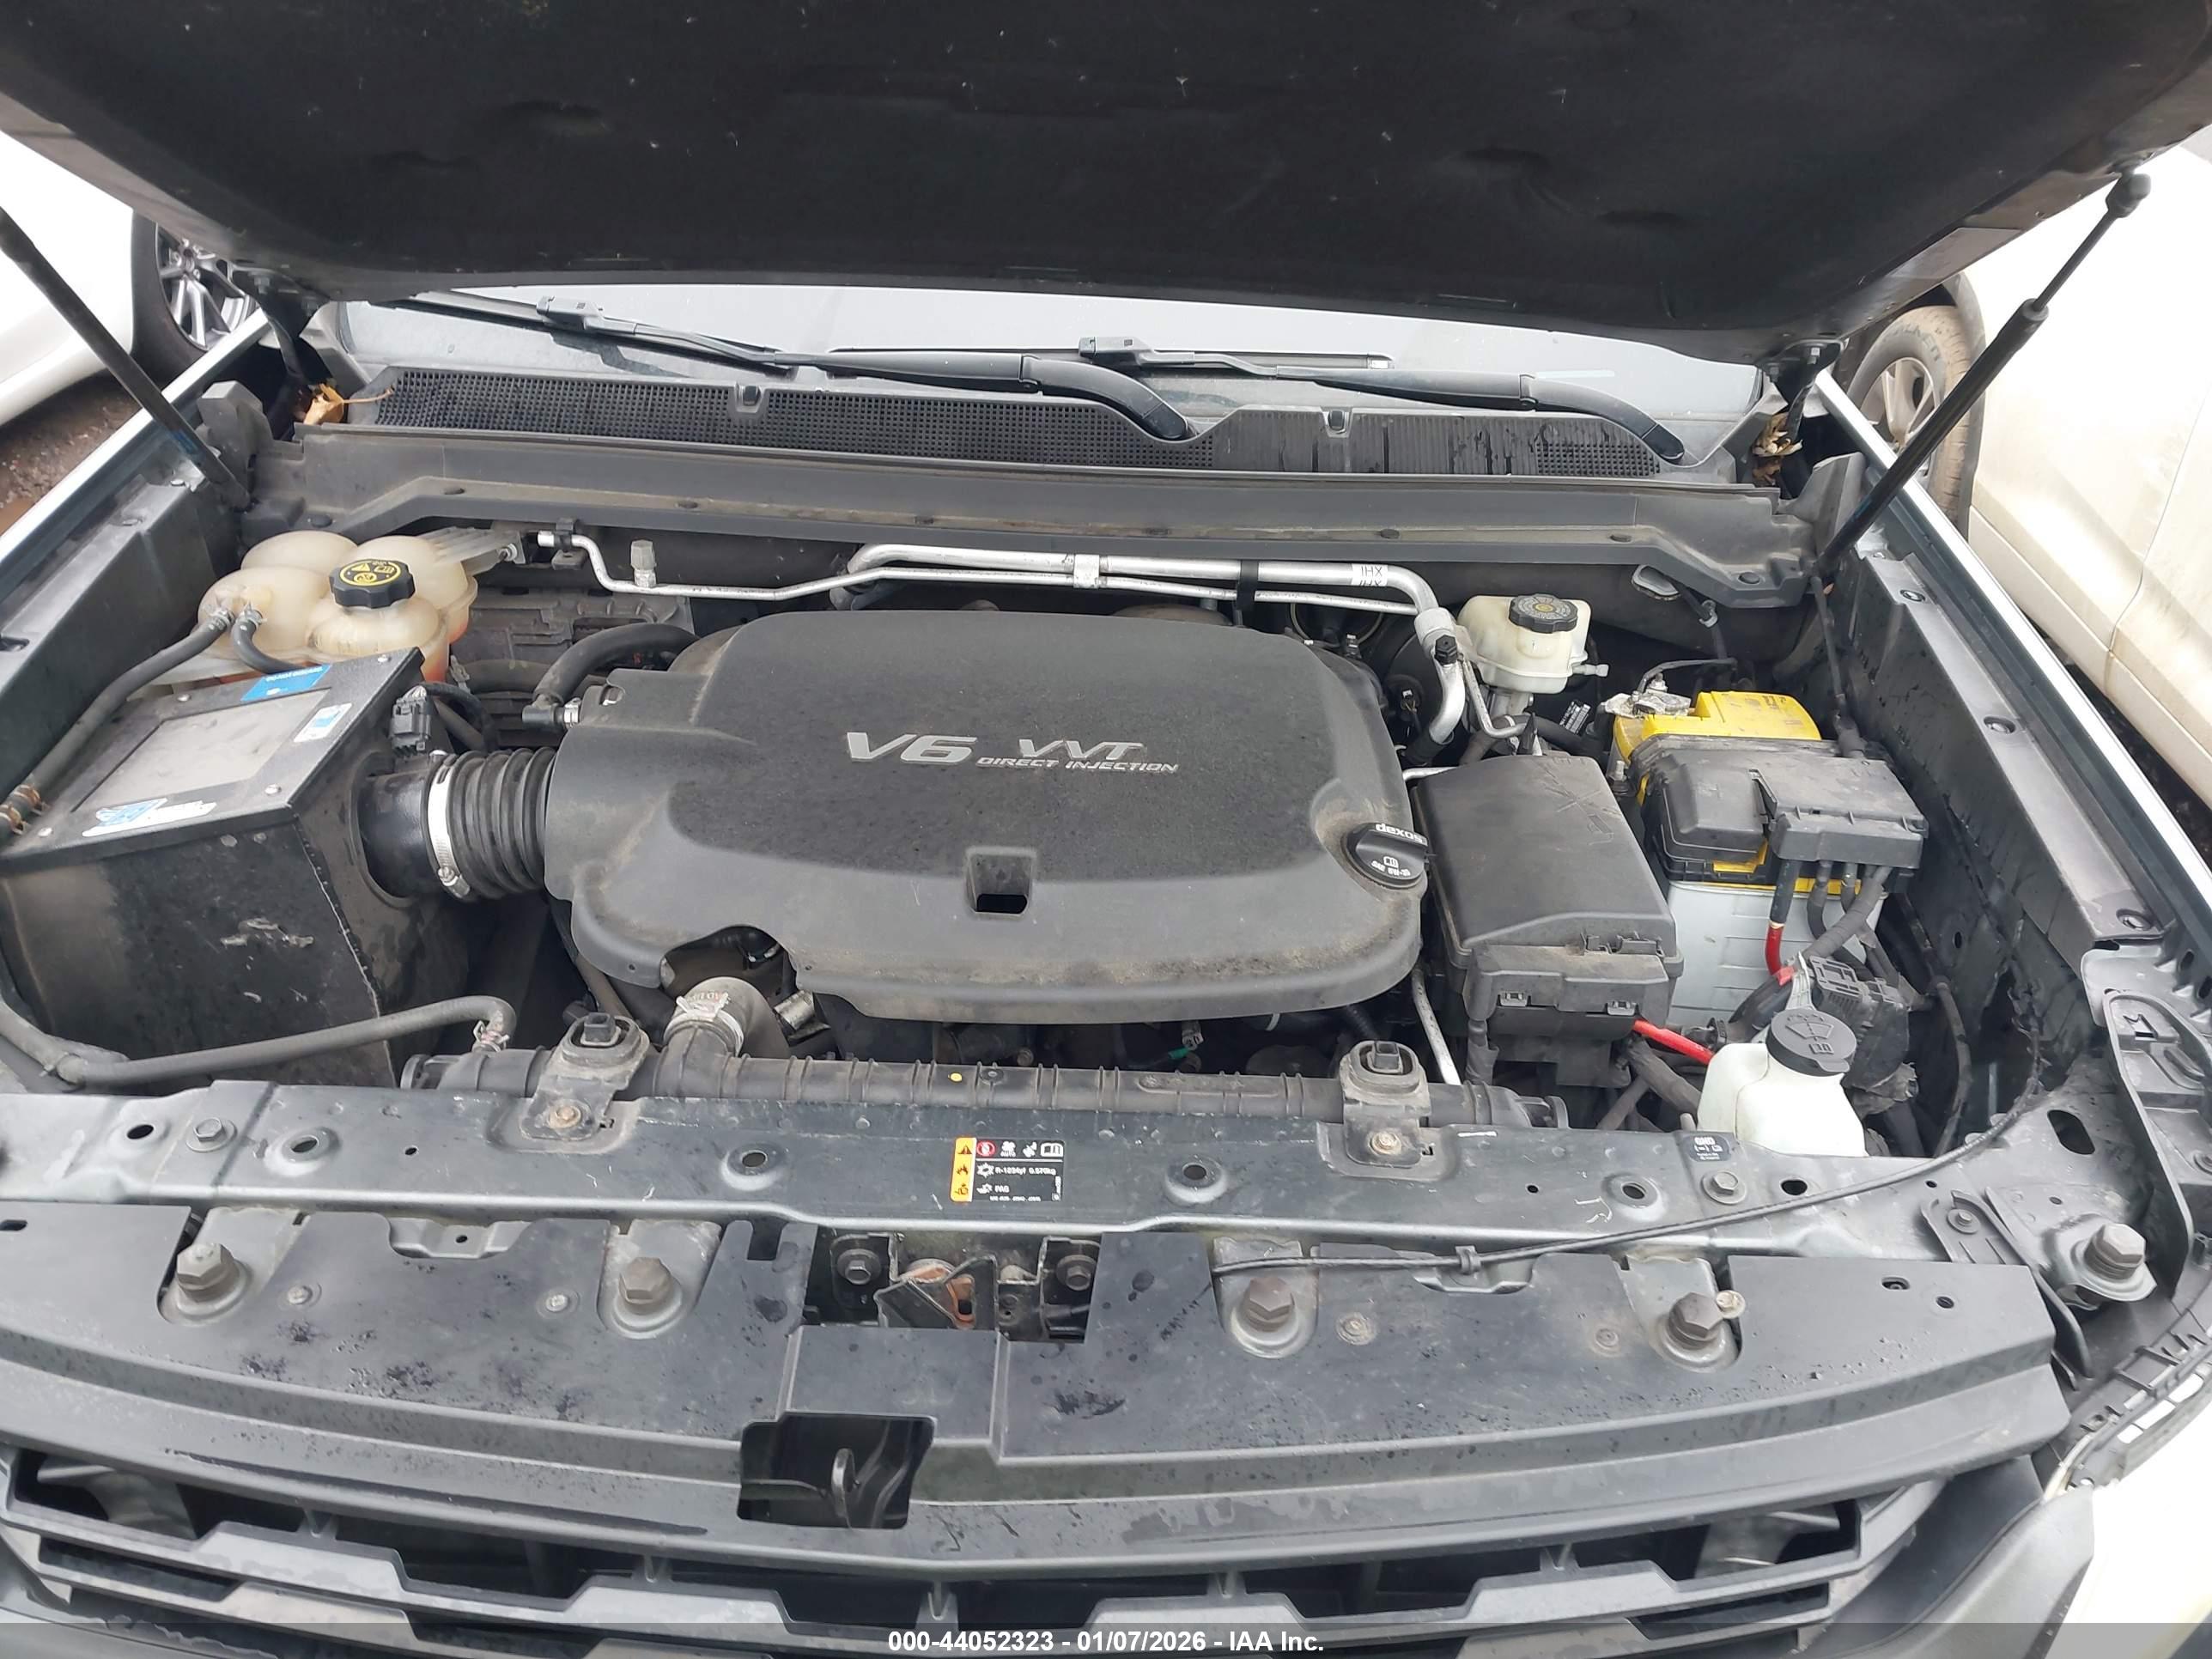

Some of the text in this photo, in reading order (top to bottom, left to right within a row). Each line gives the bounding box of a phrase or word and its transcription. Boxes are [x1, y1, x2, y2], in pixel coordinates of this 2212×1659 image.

[847, 732, 1144, 764] V6 VVT
[975, 756, 1179, 773] DIRECT INJECTION
